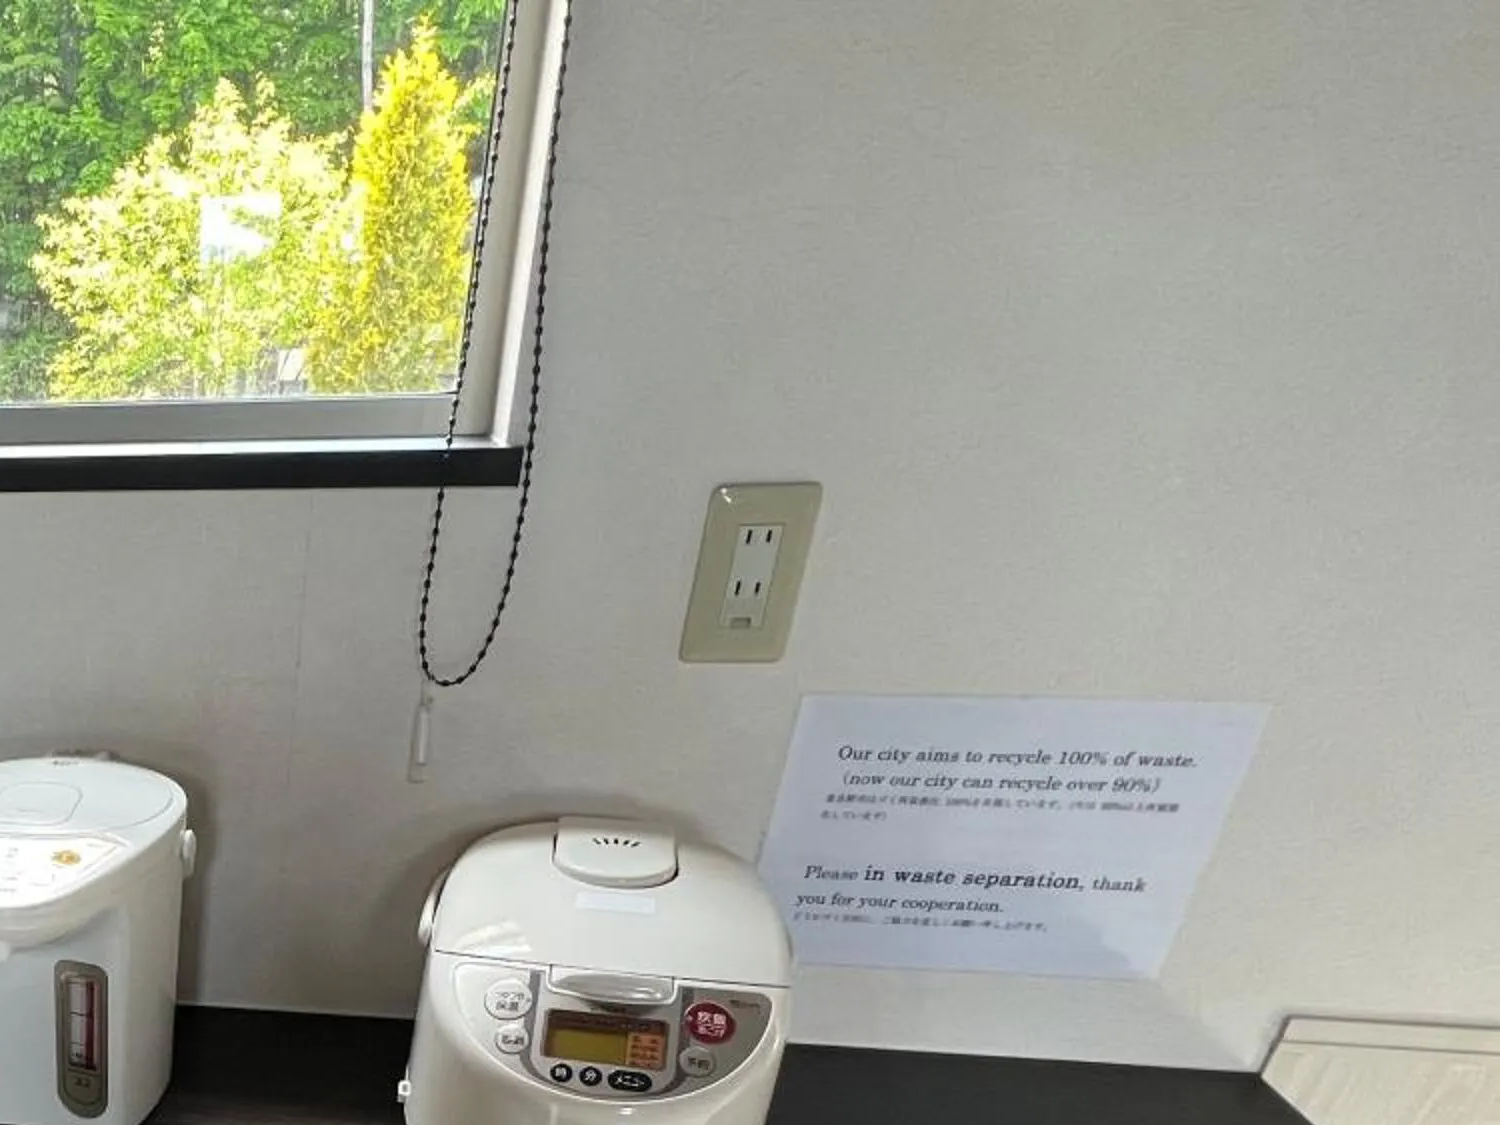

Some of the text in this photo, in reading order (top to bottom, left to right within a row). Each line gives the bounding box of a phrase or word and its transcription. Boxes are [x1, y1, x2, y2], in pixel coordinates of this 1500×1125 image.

[838, 745, 1198, 768] Our city aims to recycle 100% of waste.
[843, 770, 1162, 793] (now our city can recycle over 90%)
[803, 864, 1147, 892] Please in waste separation, thank
[795, 892, 1005, 913] you for your cooperation.
